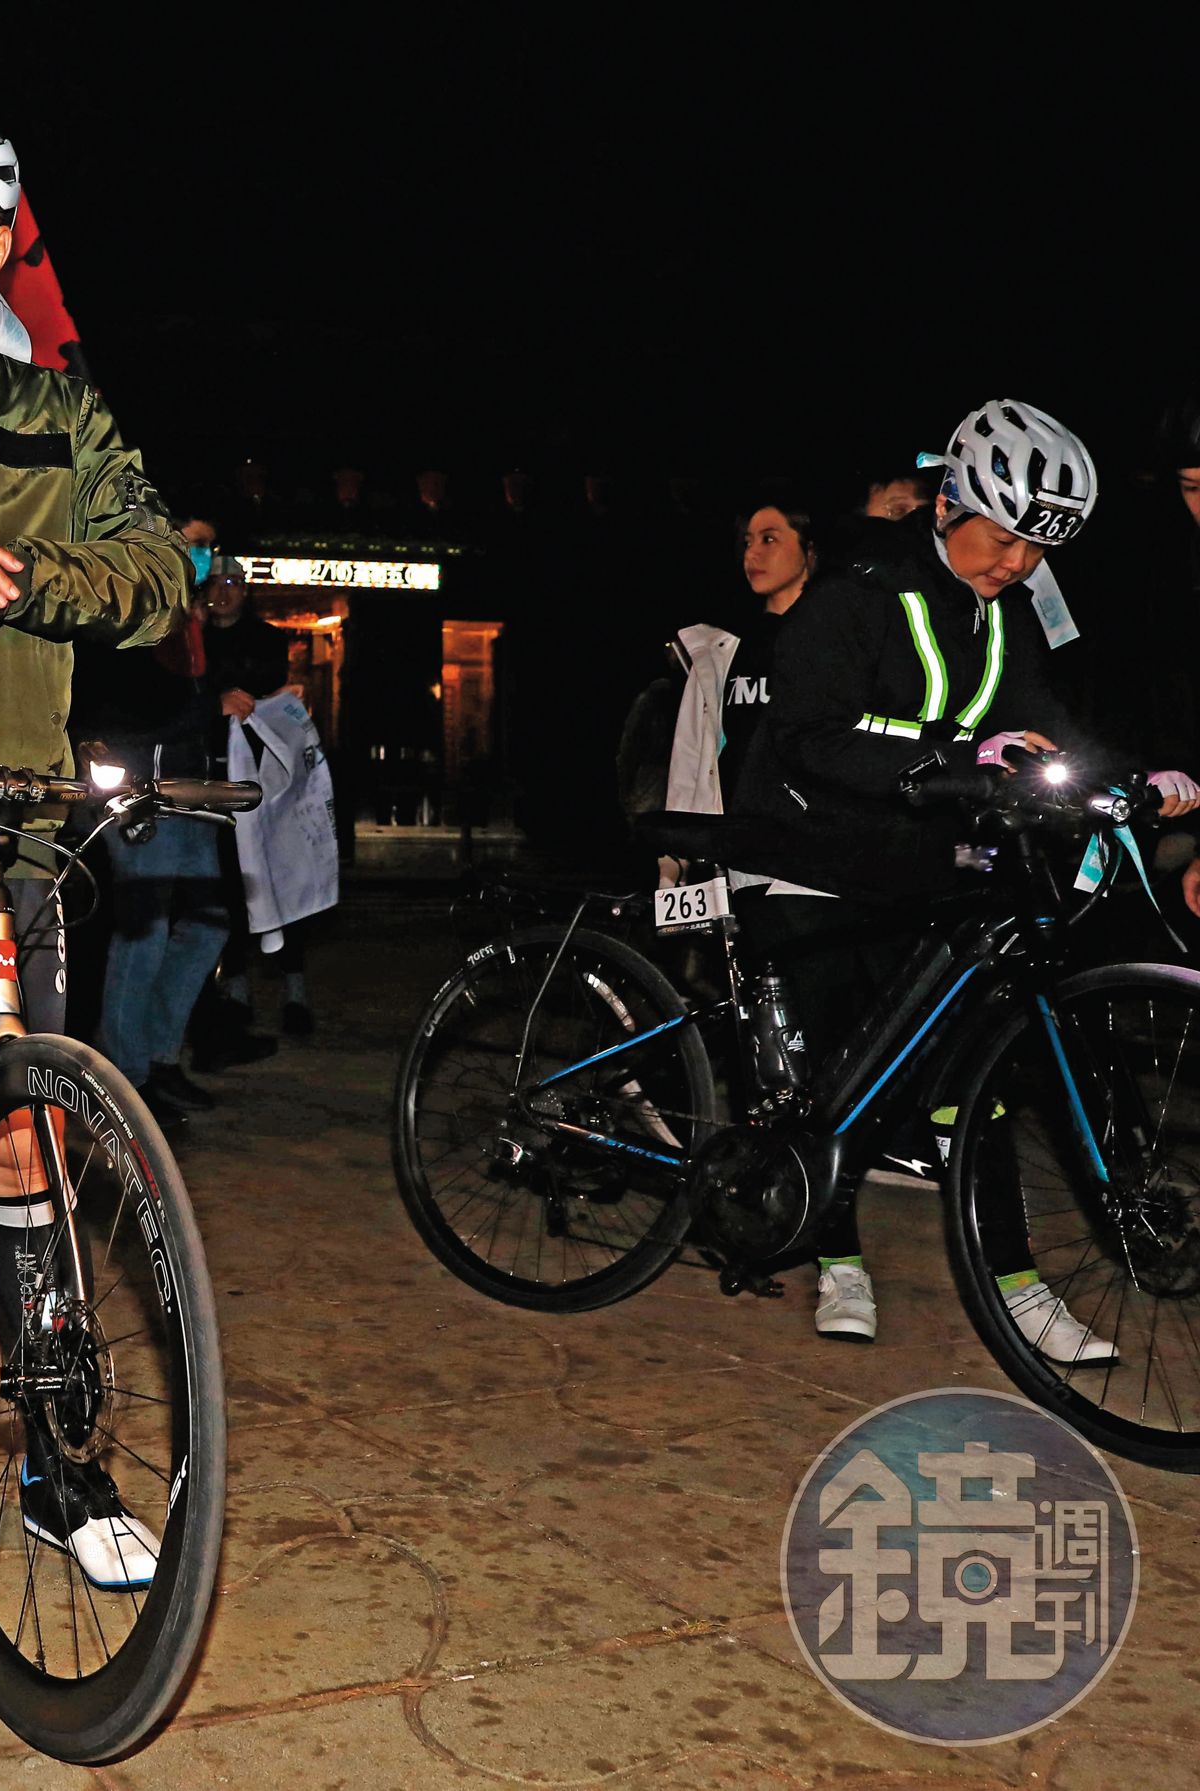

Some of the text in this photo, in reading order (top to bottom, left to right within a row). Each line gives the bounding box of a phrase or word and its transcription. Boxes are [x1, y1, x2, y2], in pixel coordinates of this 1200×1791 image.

[1029, 510, 1077, 538] 263
[663, 888, 707, 921] 263
[27, 1066, 172, 1307] NOVATEC
